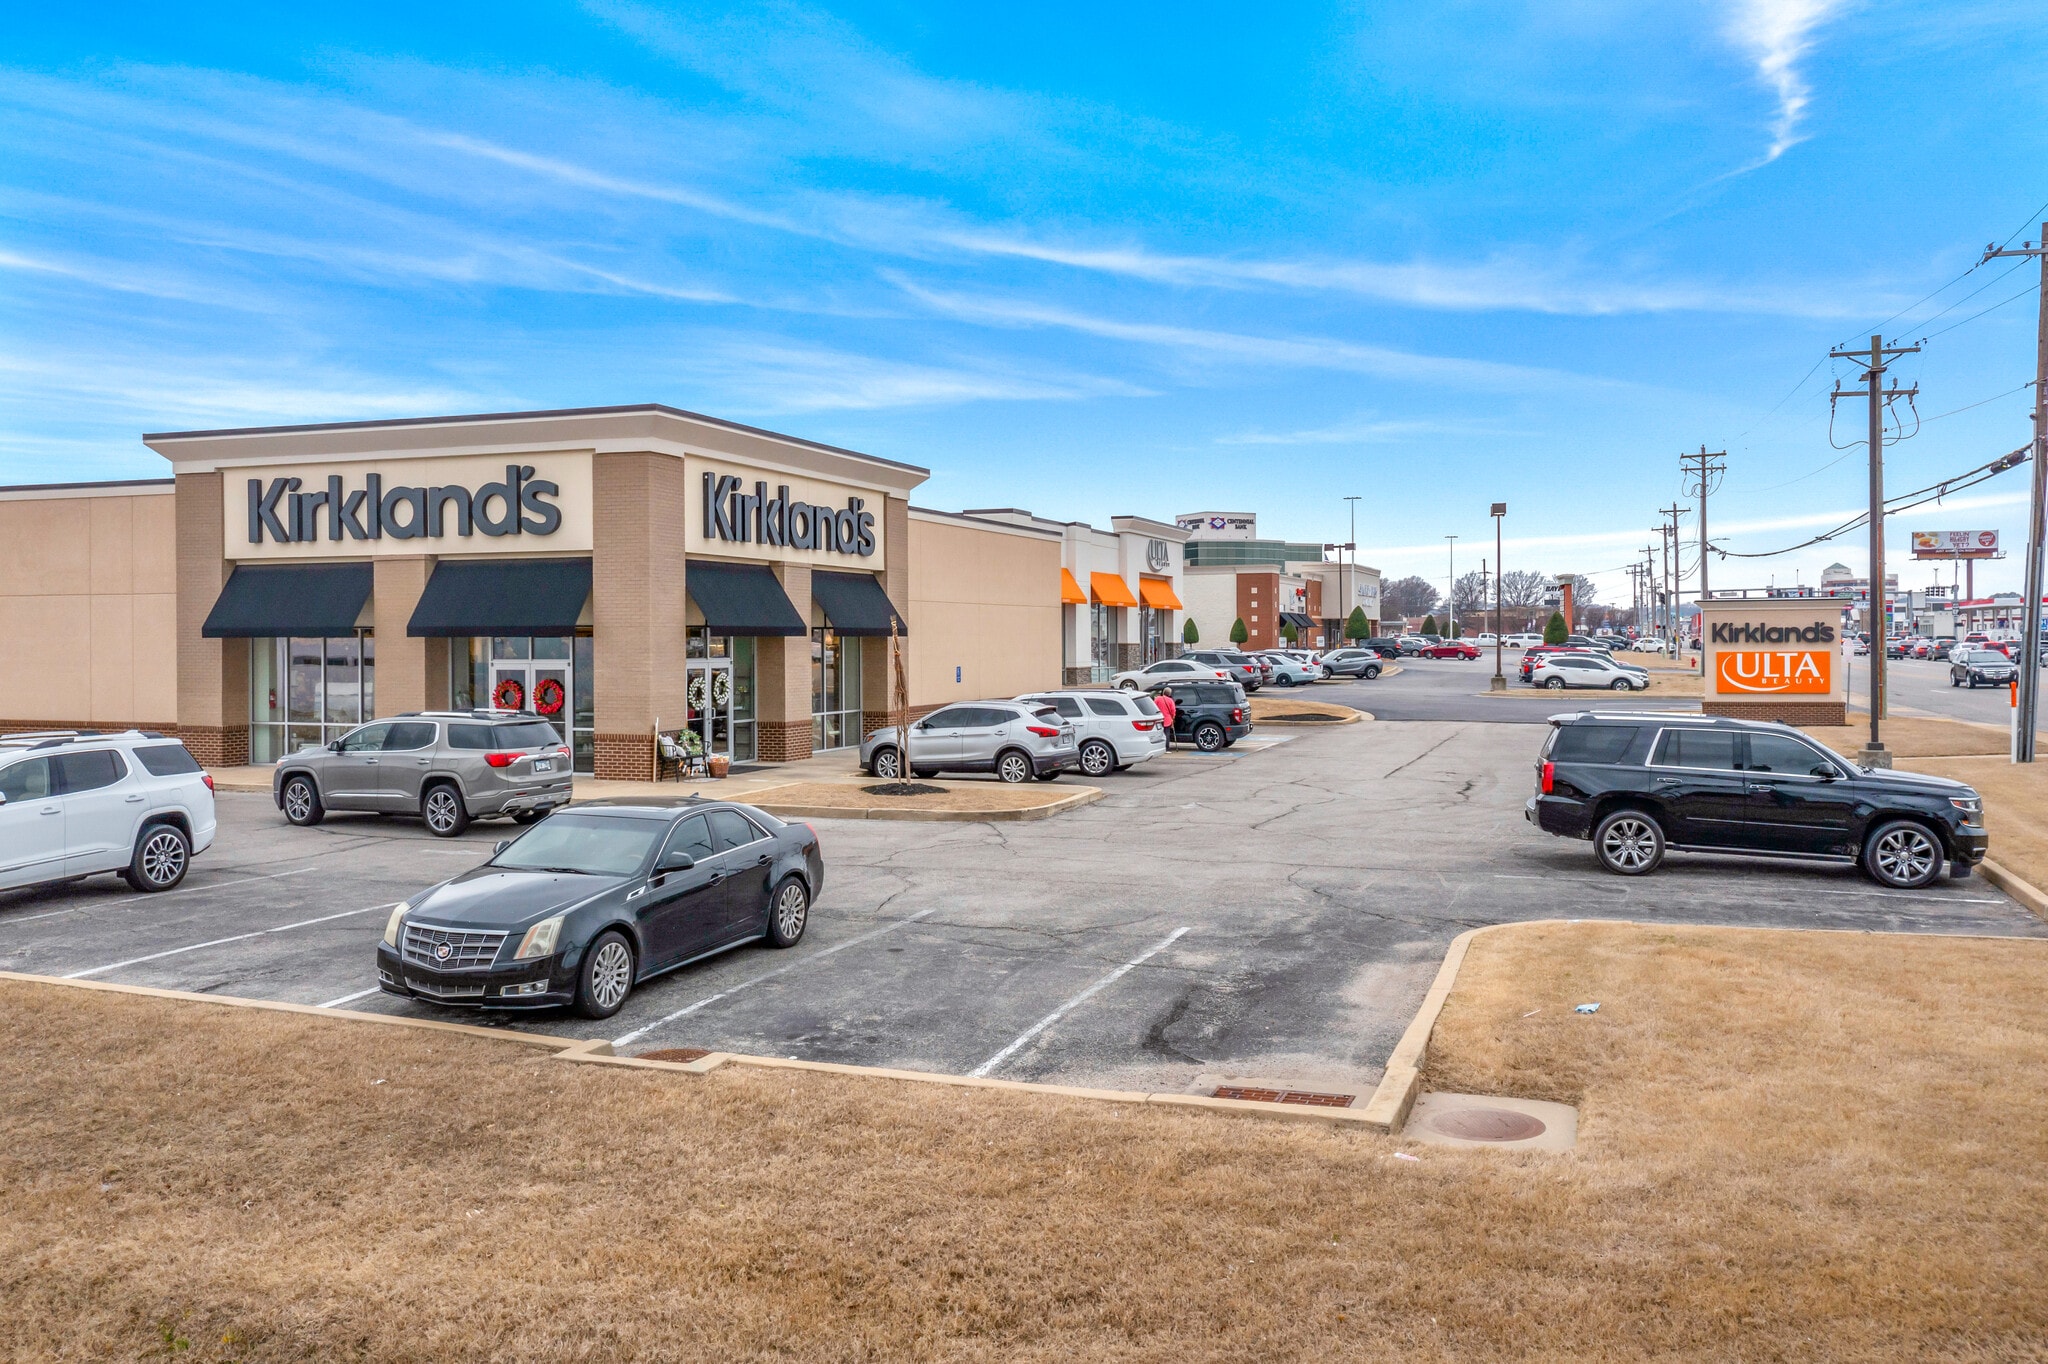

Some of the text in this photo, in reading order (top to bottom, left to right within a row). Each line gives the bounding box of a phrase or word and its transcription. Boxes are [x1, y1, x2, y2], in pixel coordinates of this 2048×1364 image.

[248, 464, 562, 544] Kirkland's
[702, 471, 876, 557] Kirkland's
[1711, 622, 1835, 643] Kirkland's
[1736, 652, 1821, 678] ULTA
